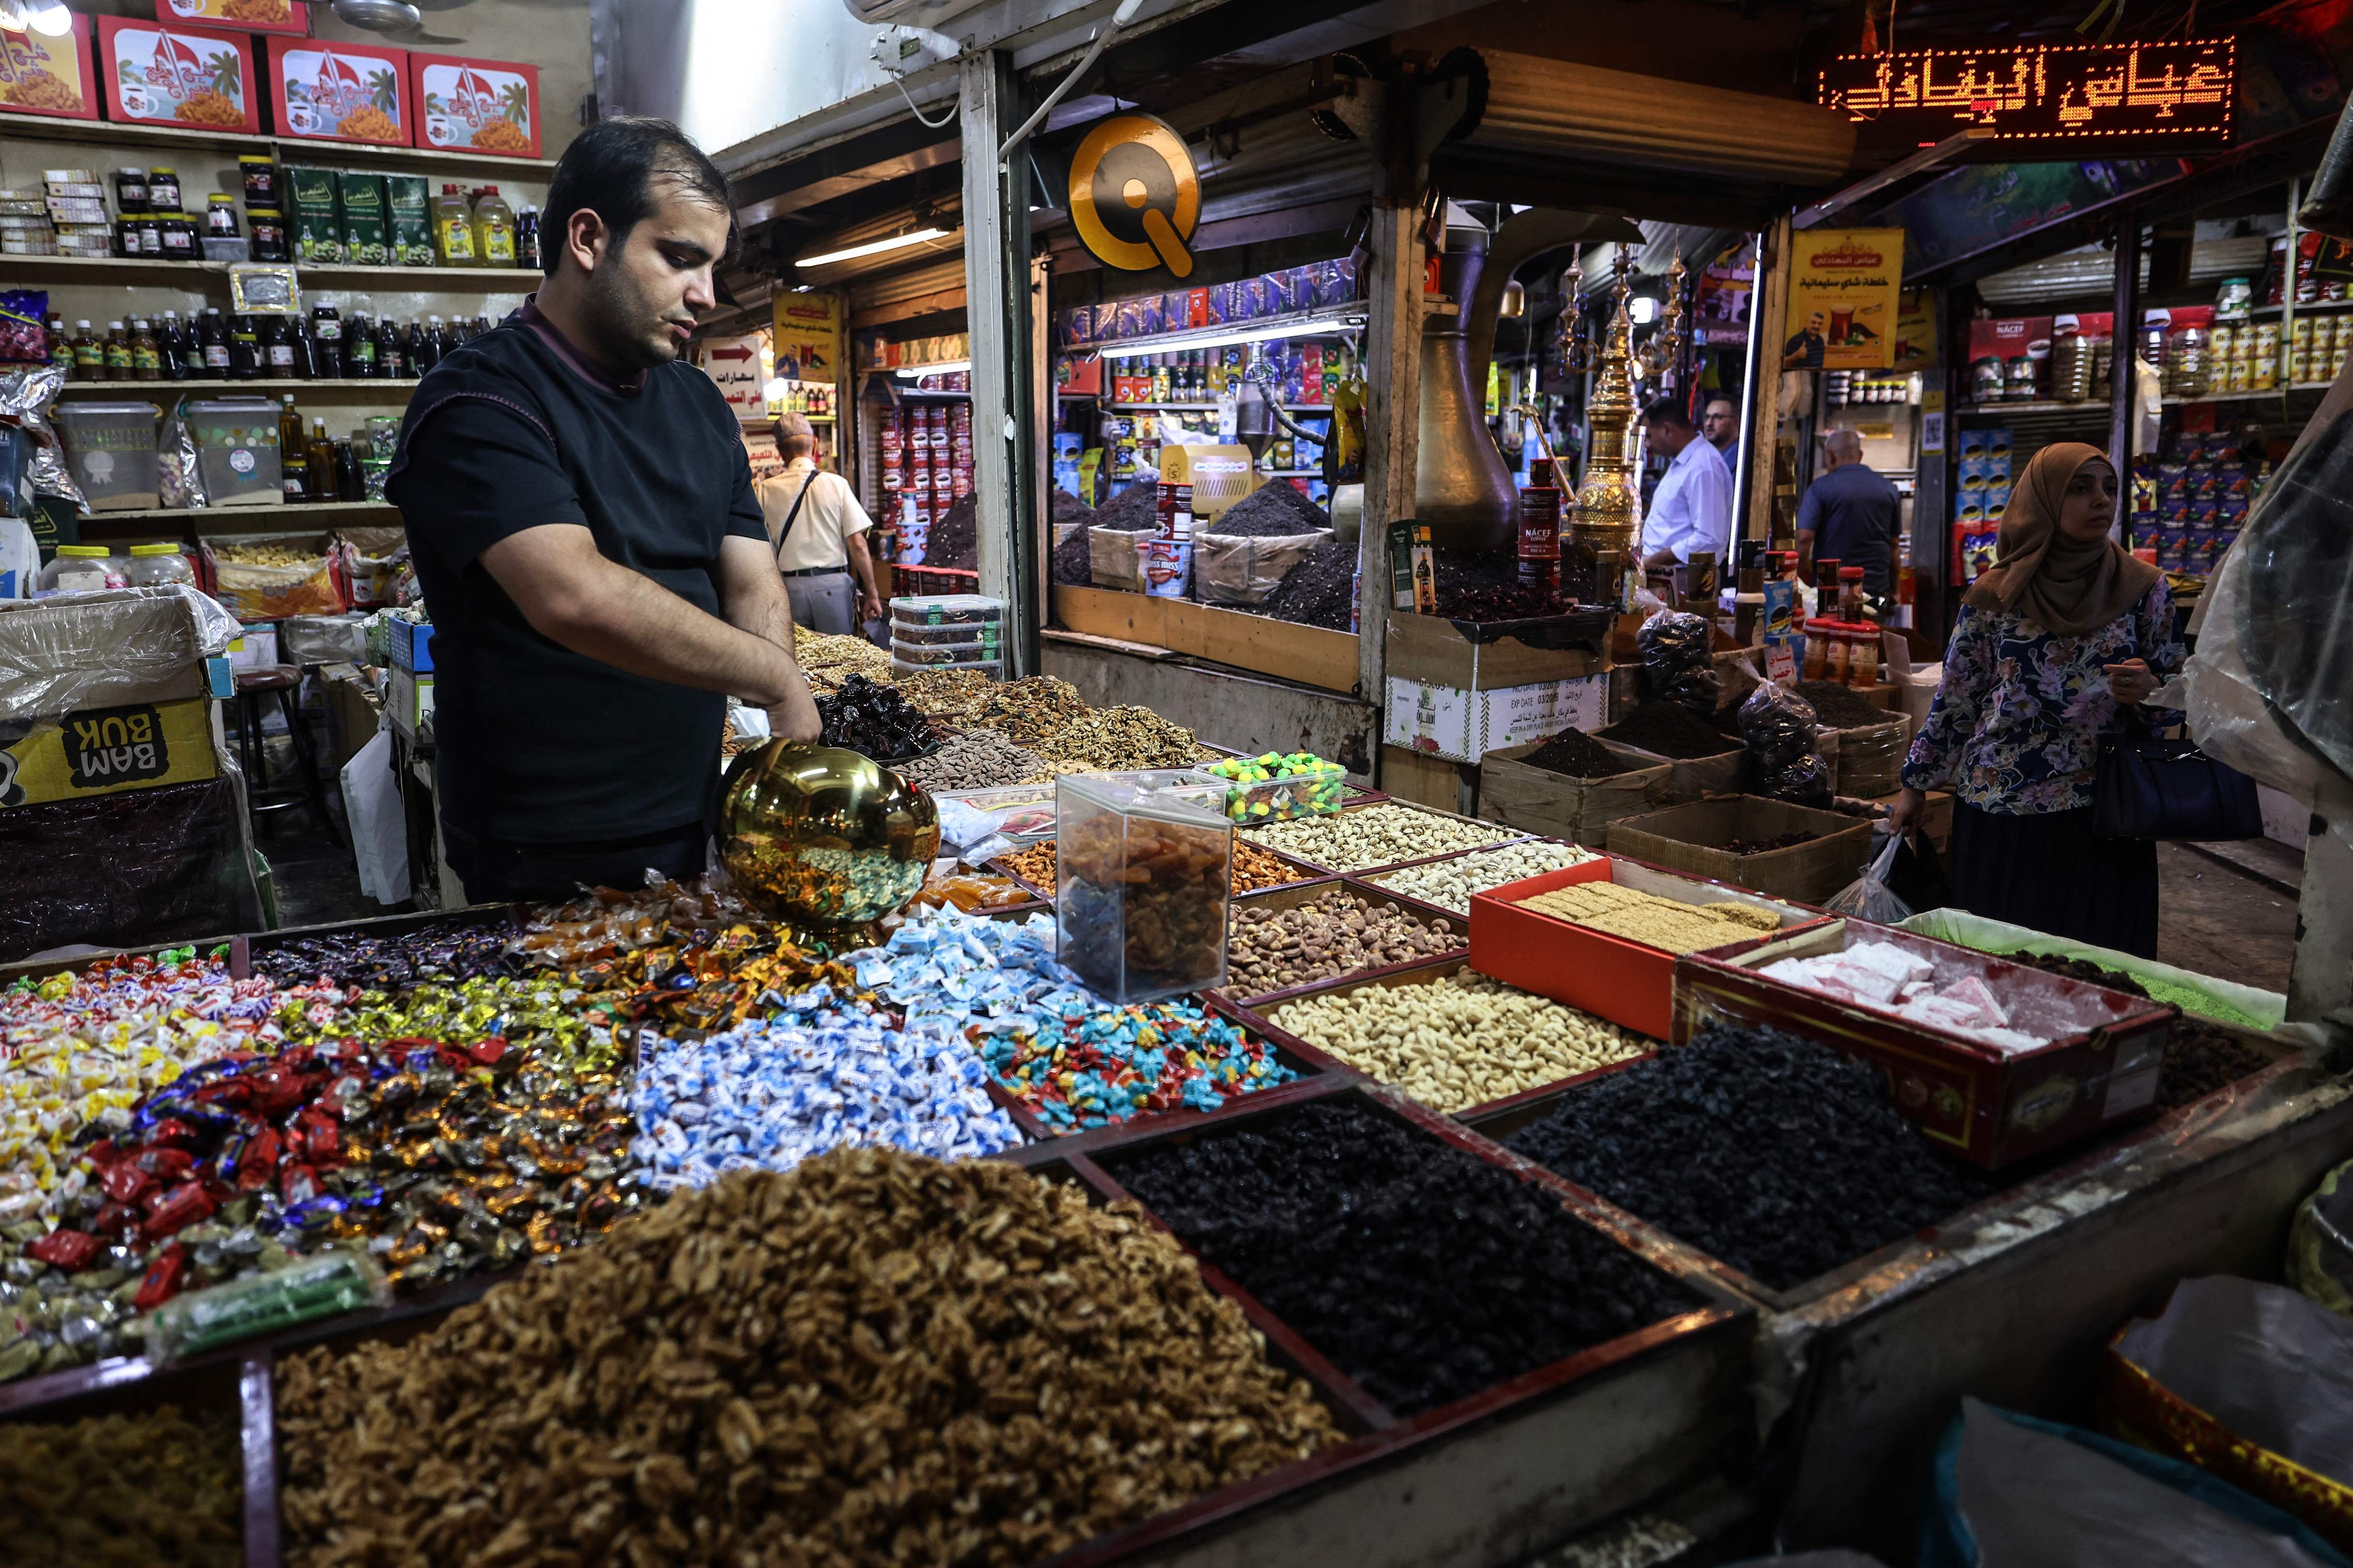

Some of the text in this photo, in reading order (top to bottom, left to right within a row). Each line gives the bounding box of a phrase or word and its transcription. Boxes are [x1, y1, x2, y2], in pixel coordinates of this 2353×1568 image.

[716, 371, 754, 385] بهارات
[1526, 528, 1552, 537] NÁCEF
[1769, 647, 1792, 667] شاي
[1773, 666, 1795, 682] اخضر
[1511, 700, 1520, 709] EXP
[1521, 698, 1534, 707] DATE
[73, 713, 153, 750] BUK
[1534, 722, 1545, 730] PLACE
[80, 743, 156, 777] BAM
